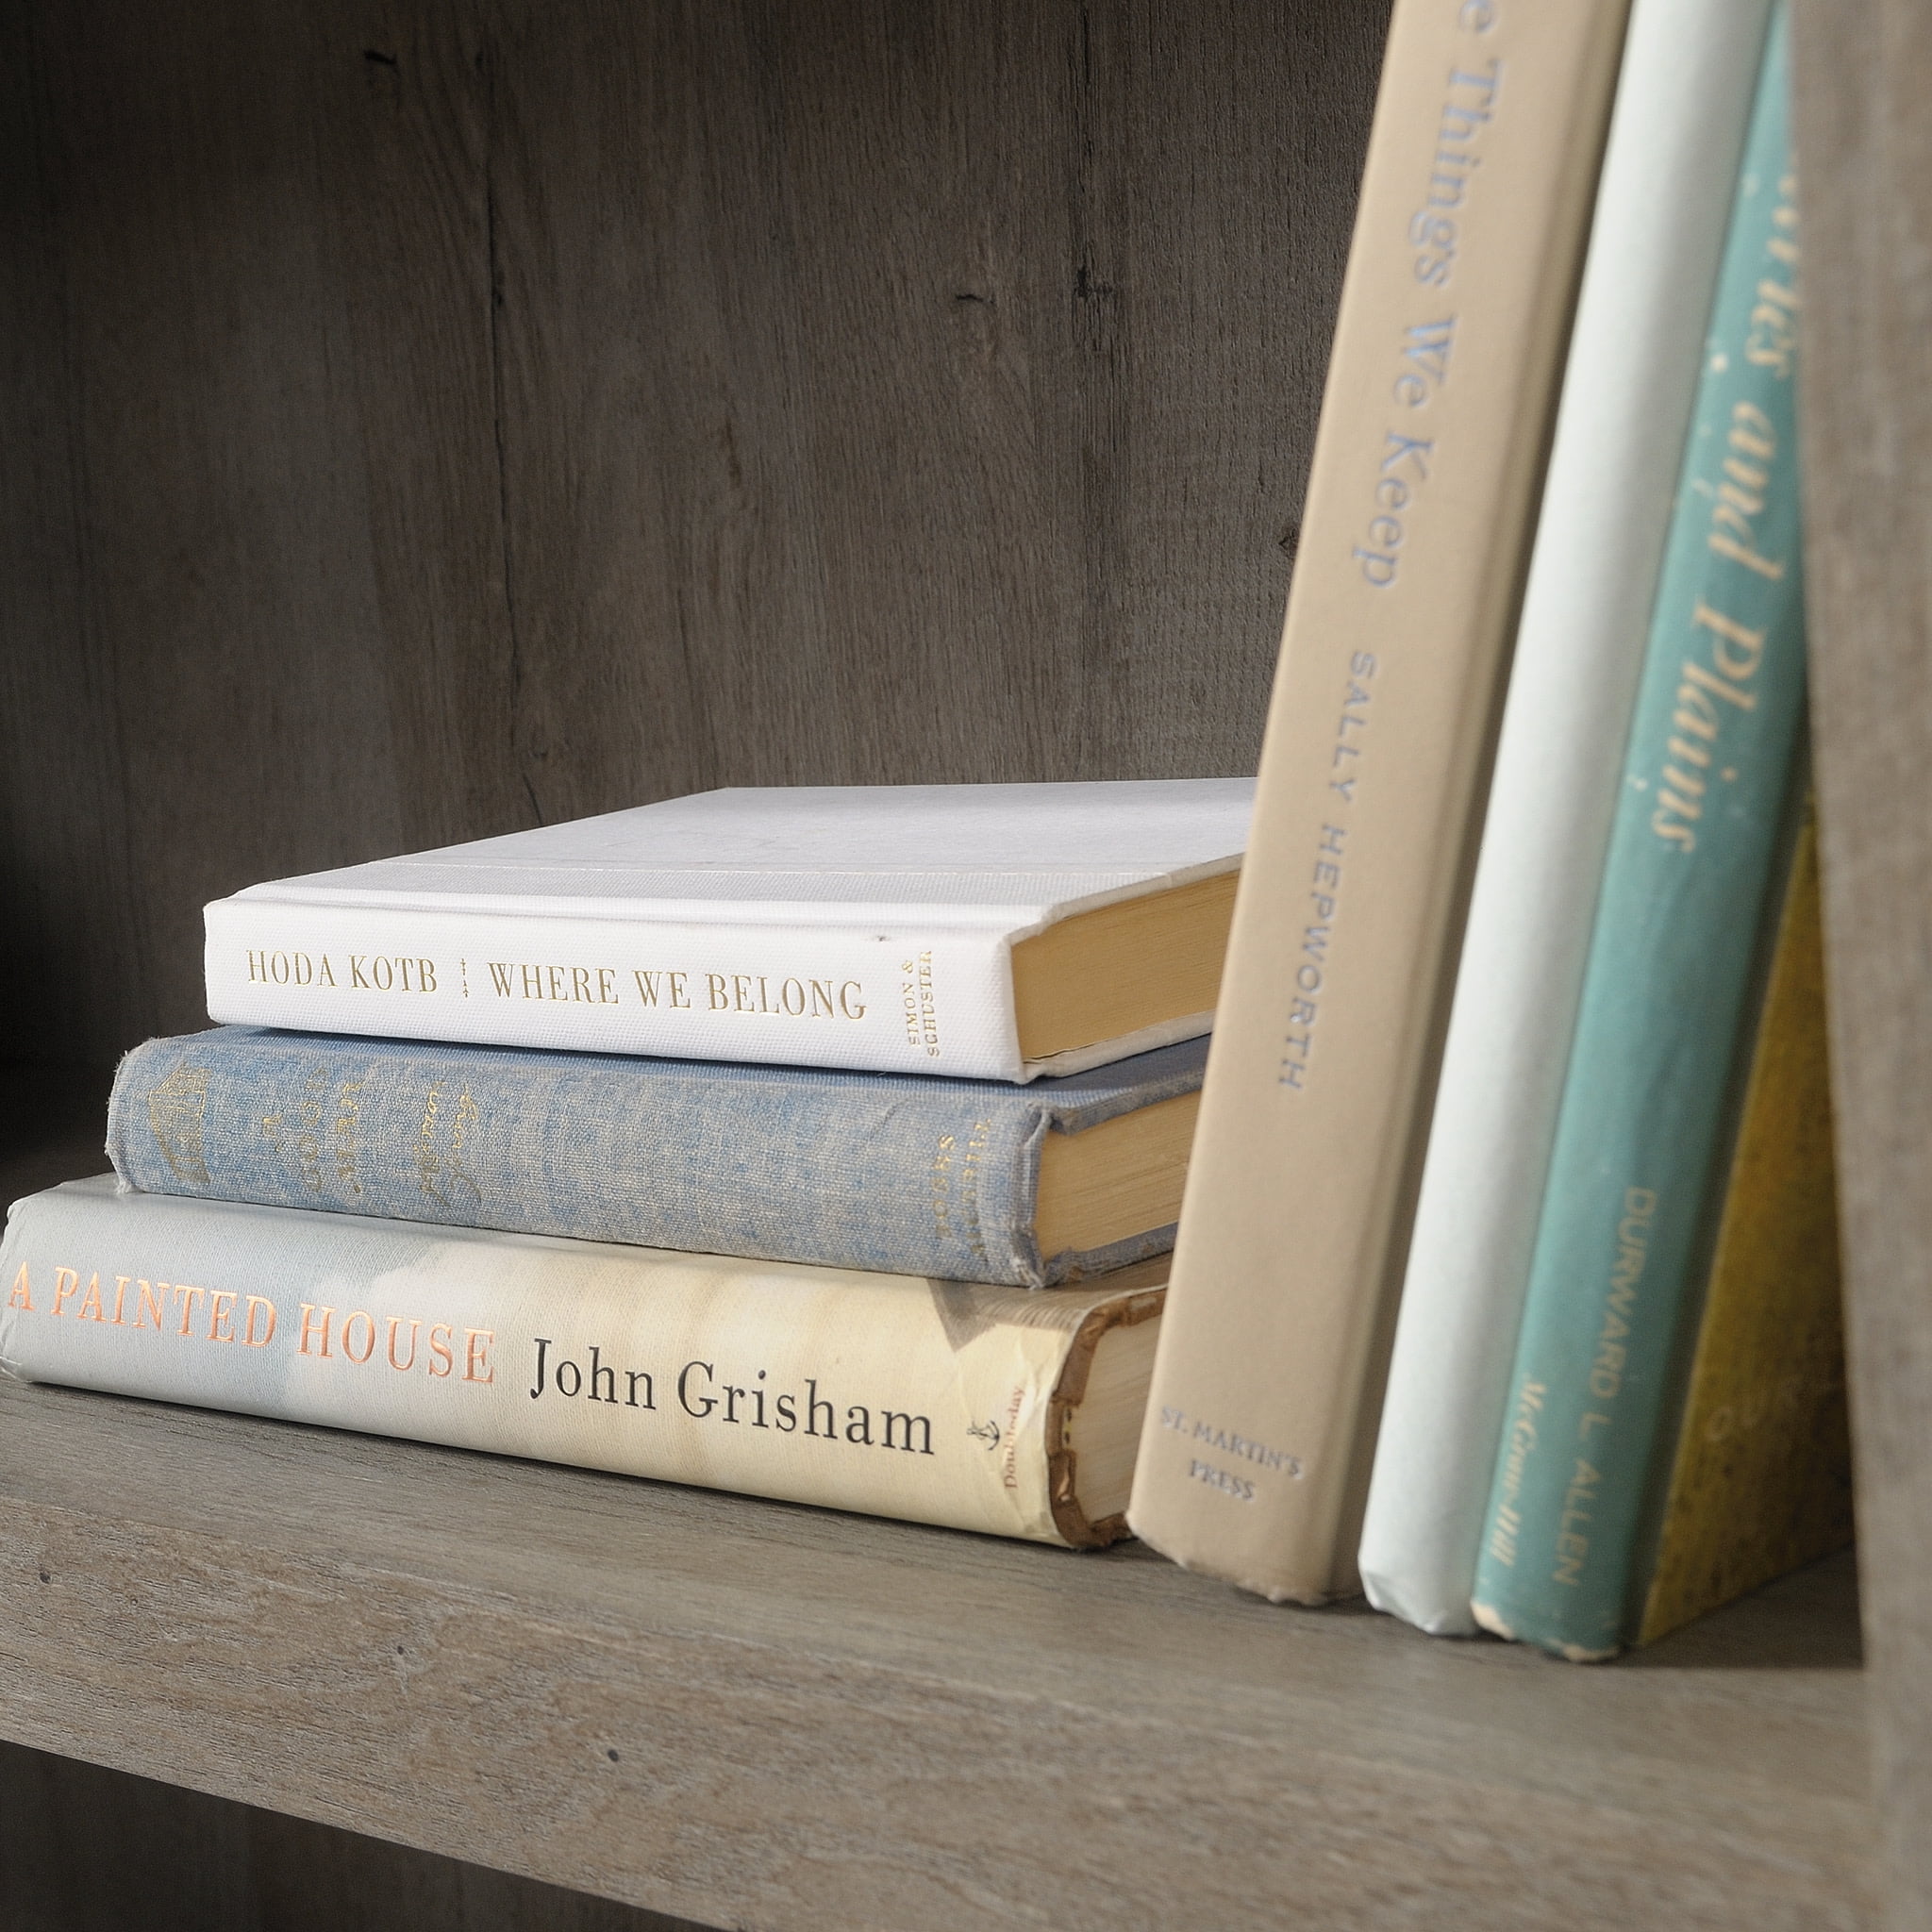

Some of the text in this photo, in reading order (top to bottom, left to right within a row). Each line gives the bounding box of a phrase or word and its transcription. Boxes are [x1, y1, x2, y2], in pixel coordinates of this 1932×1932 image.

[1409, 58, 1504, 285] Things
[1392, 316, 1458, 408] We
[1353, 430, 1434, 589] Keep
[1707, 401, 1783, 580] and
[1651, 594, 1766, 852] Plains
[1277, 649, 1377, 1092] SALLY HEPWORTH
[246, 949, 439, 993] HODA KOTB
[489, 961, 869, 1022] WHERE WE BELONG
[902, 959, 921, 1045] SIMON &
[919, 950, 941, 1057] SCHUSTER
[8, 1261, 495, 1384] A PAINTED HOUSE
[1588, 1185, 1658, 1400] DURWARD
[529, 1338, 936, 1456] John Grisham
[1188, 1458, 1256, 1501] PRESS
[1551, 1457, 1604, 1588] ALLEN
